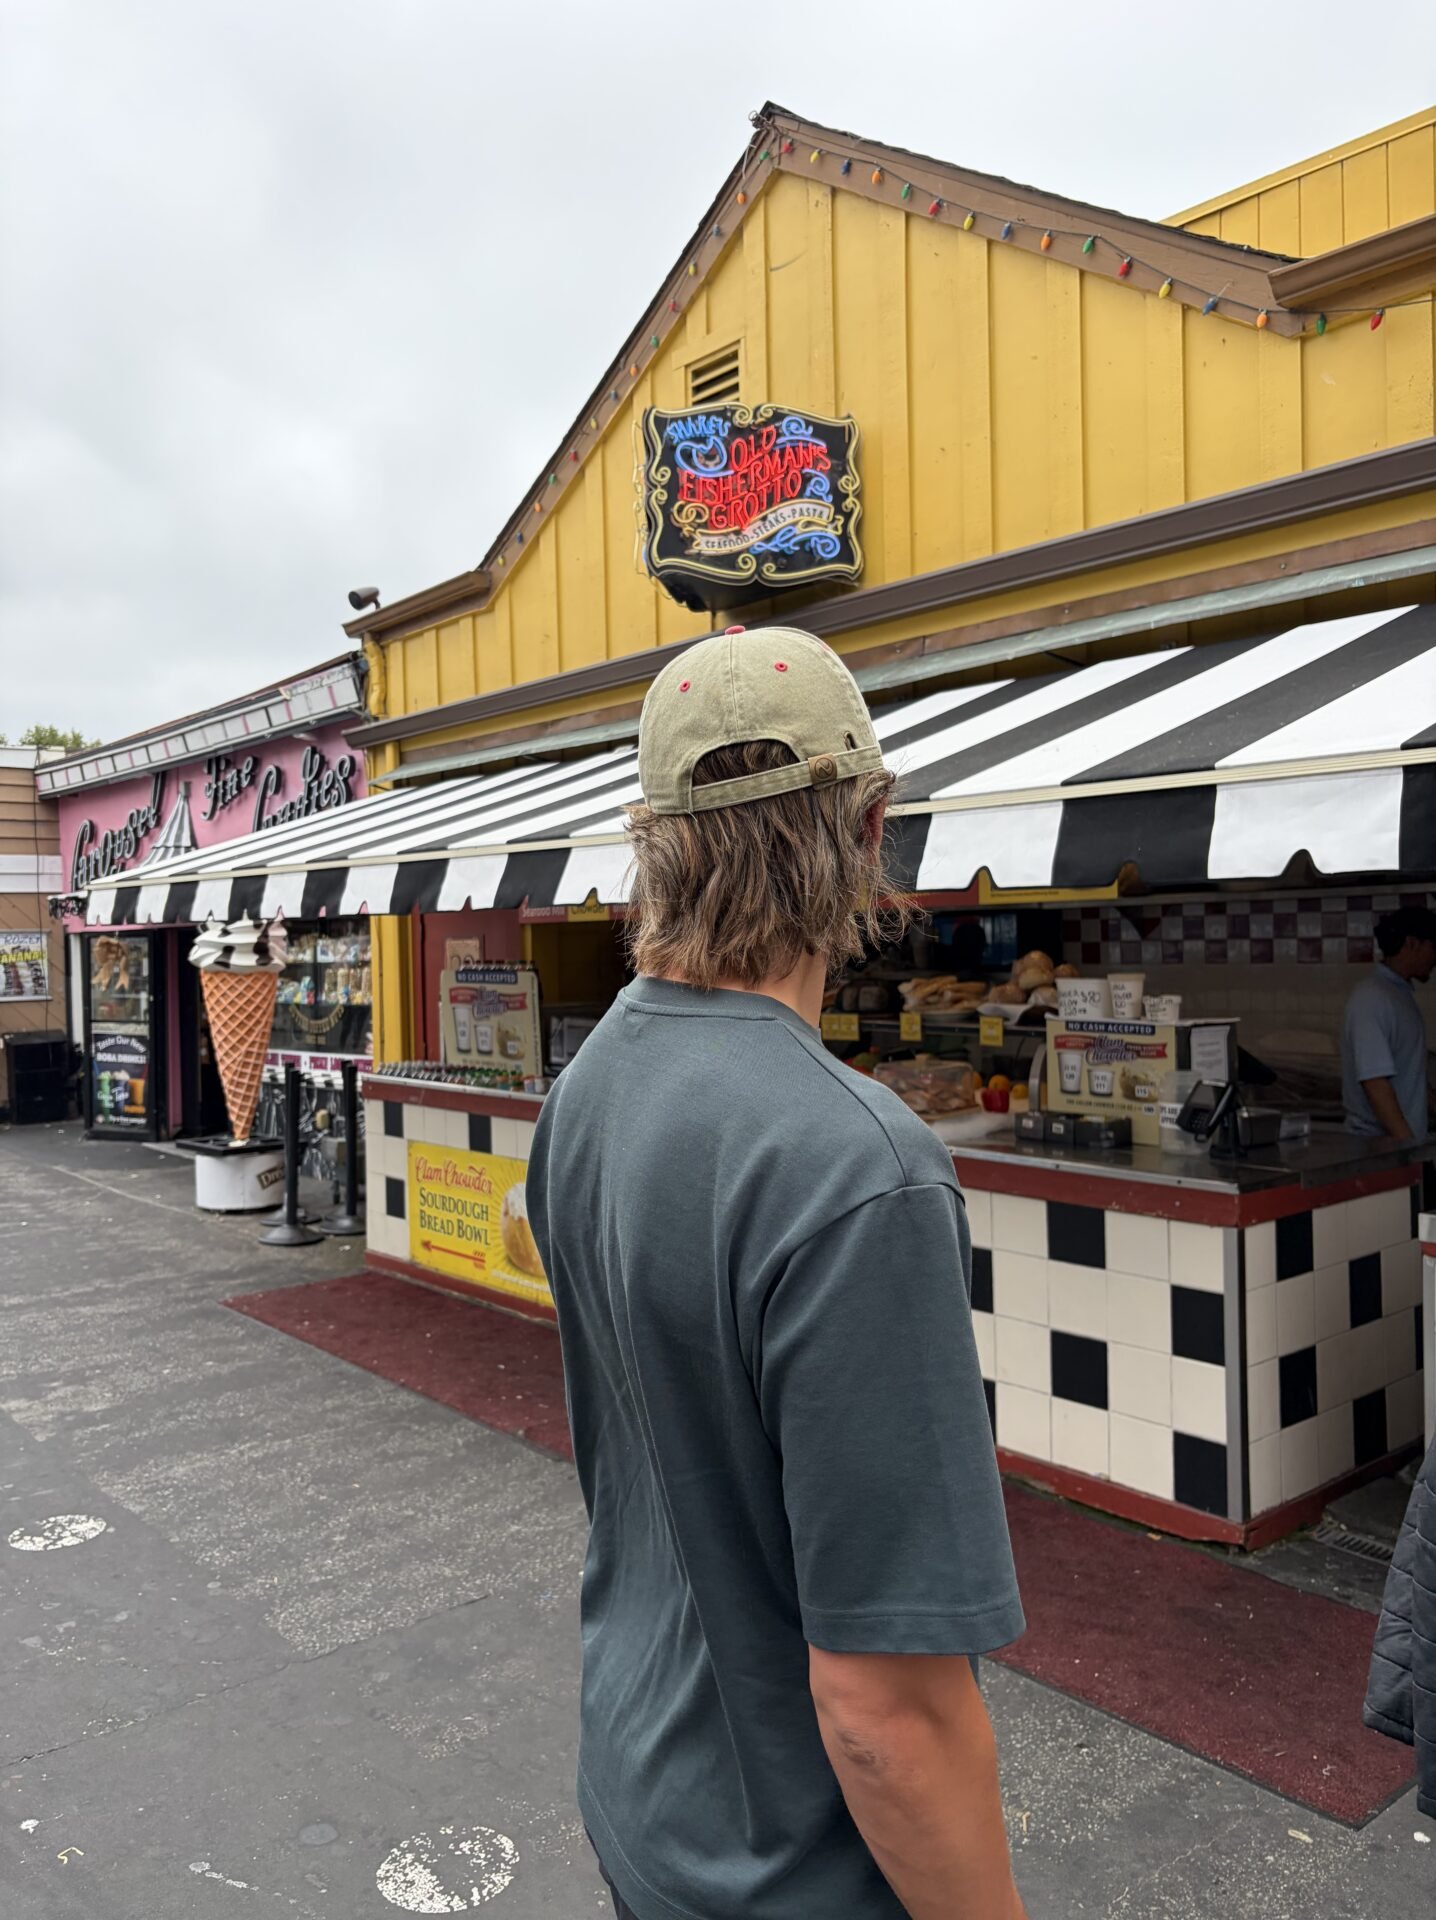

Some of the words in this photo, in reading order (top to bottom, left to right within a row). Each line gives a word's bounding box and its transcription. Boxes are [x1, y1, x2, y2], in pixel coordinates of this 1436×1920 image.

[730, 424, 776, 472] OLD
[709, 470, 801, 529] GROTTO
[201, 756, 257, 820] Fine
[72, 771, 165, 892] Carousel
[467, 973, 483, 982] CASH
[484, 974, 515, 983] ACCEPTED
[116, 1034, 130, 1046] Our
[1068, 1022, 1080, 1030] NO
[1082, 1023, 1105, 1032] CASH
[1107, 1024, 1152, 1034] ACCEPTED
[415, 1156, 442, 1183] Clam
[444, 1159, 493, 1195] Chowder
[419, 1186, 489, 1222] SOURDOUGH
[419, 1209, 455, 1236] BREAD
[457, 1218, 491, 1246] BOWL
